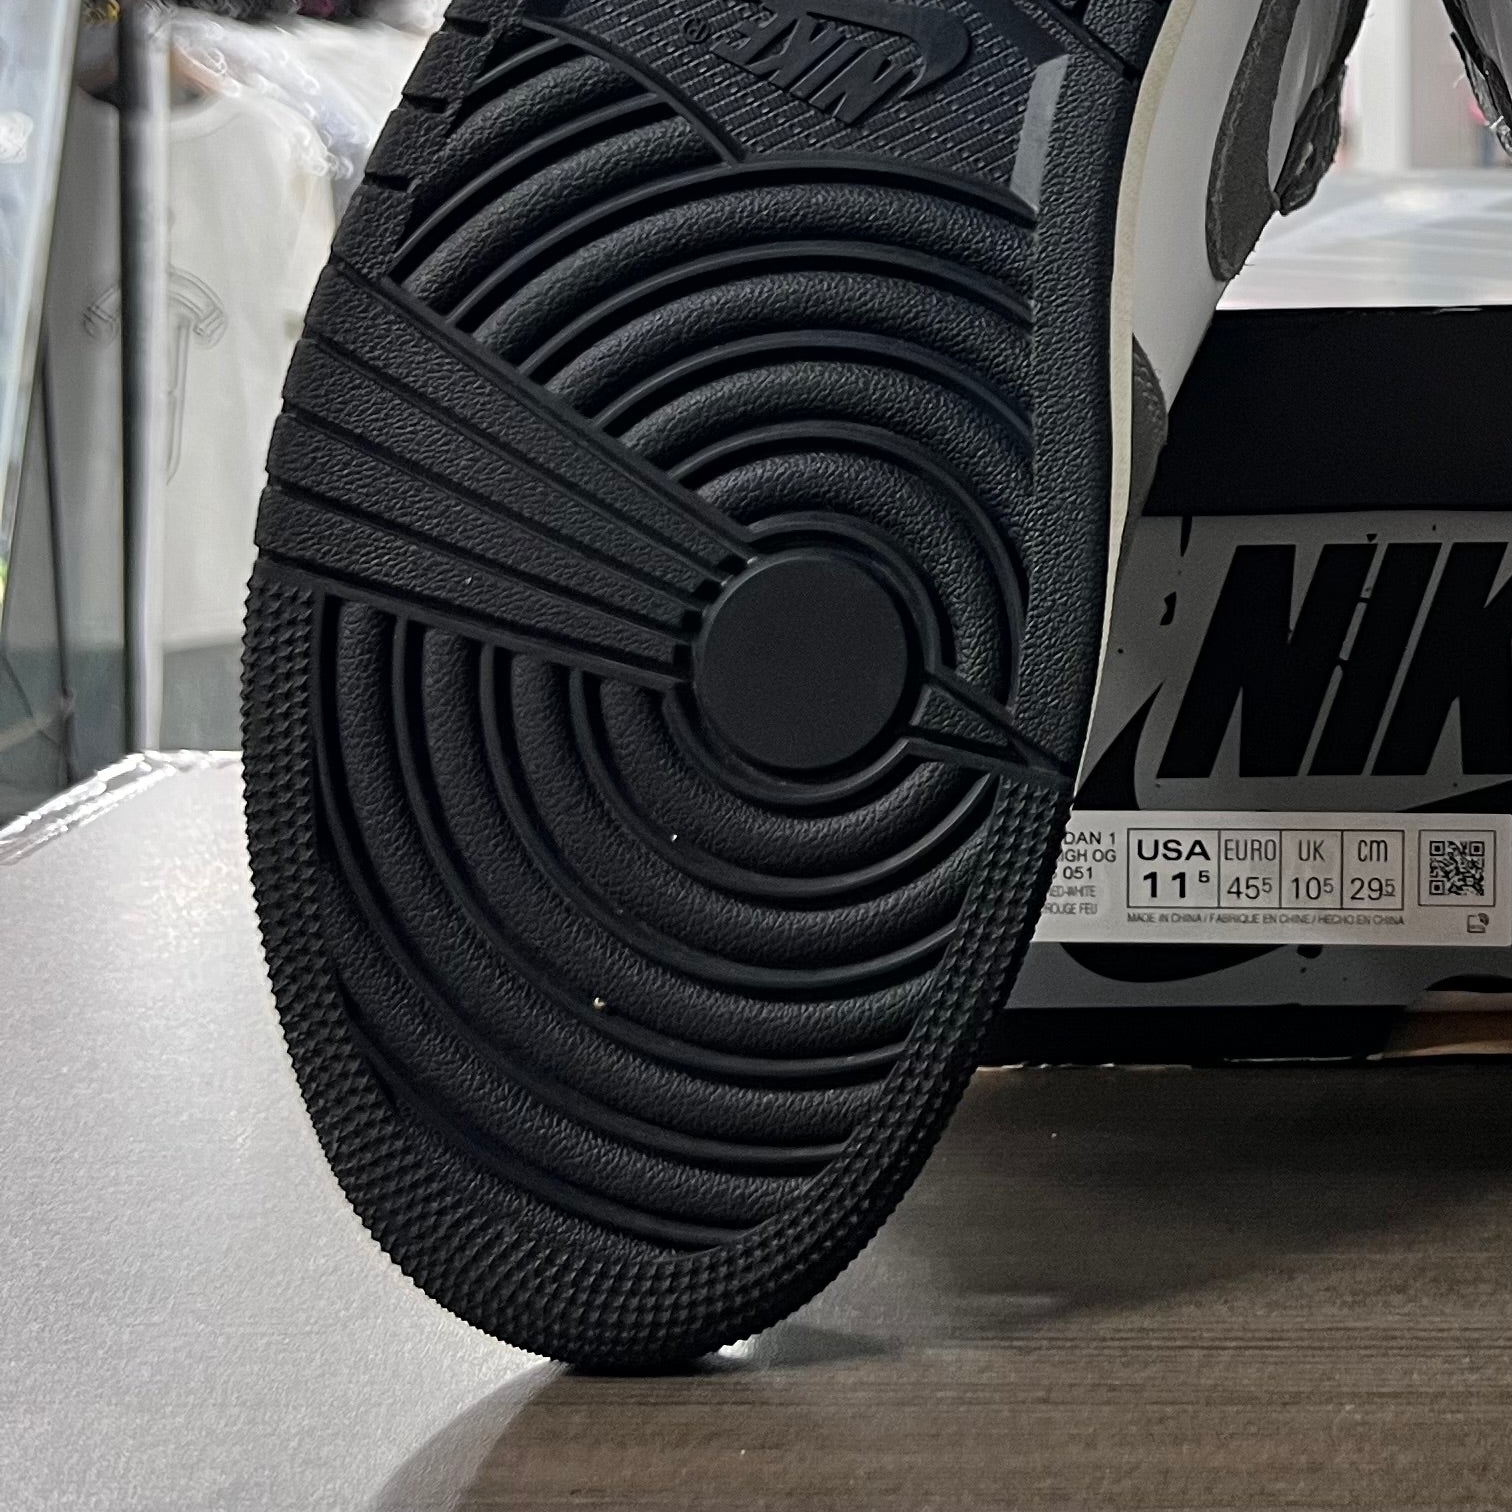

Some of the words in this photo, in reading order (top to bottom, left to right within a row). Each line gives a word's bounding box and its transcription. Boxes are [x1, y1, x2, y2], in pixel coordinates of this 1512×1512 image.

[709, 6, 915, 124] NIKE
[1063, 831, 1101, 845] DAN
[1109, 831, 1115, 845] 1
[1060, 848, 1088, 863] IGH
[1092, 848, 1117, 863] OG
[1137, 838, 1211, 861] USA
[1223, 838, 1277, 862] EURO
[1298, 839, 1326, 862] UK
[1062, 866, 1093, 879] 051
[1080, 902, 1098, 915] FEU
[1127, 912, 1157, 922] MADE
[1158, 912, 1169, 922] IN
[1171, 912, 1201, 922] CHINA
[1210, 913, 1260, 923] FABRIQUE
[1262, 913, 1276, 923] EN
[1318, 913, 1355, 924] HECHO
[1356, 914, 1370, 924] EN
[1373, 914, 1405, 925] CHINA
